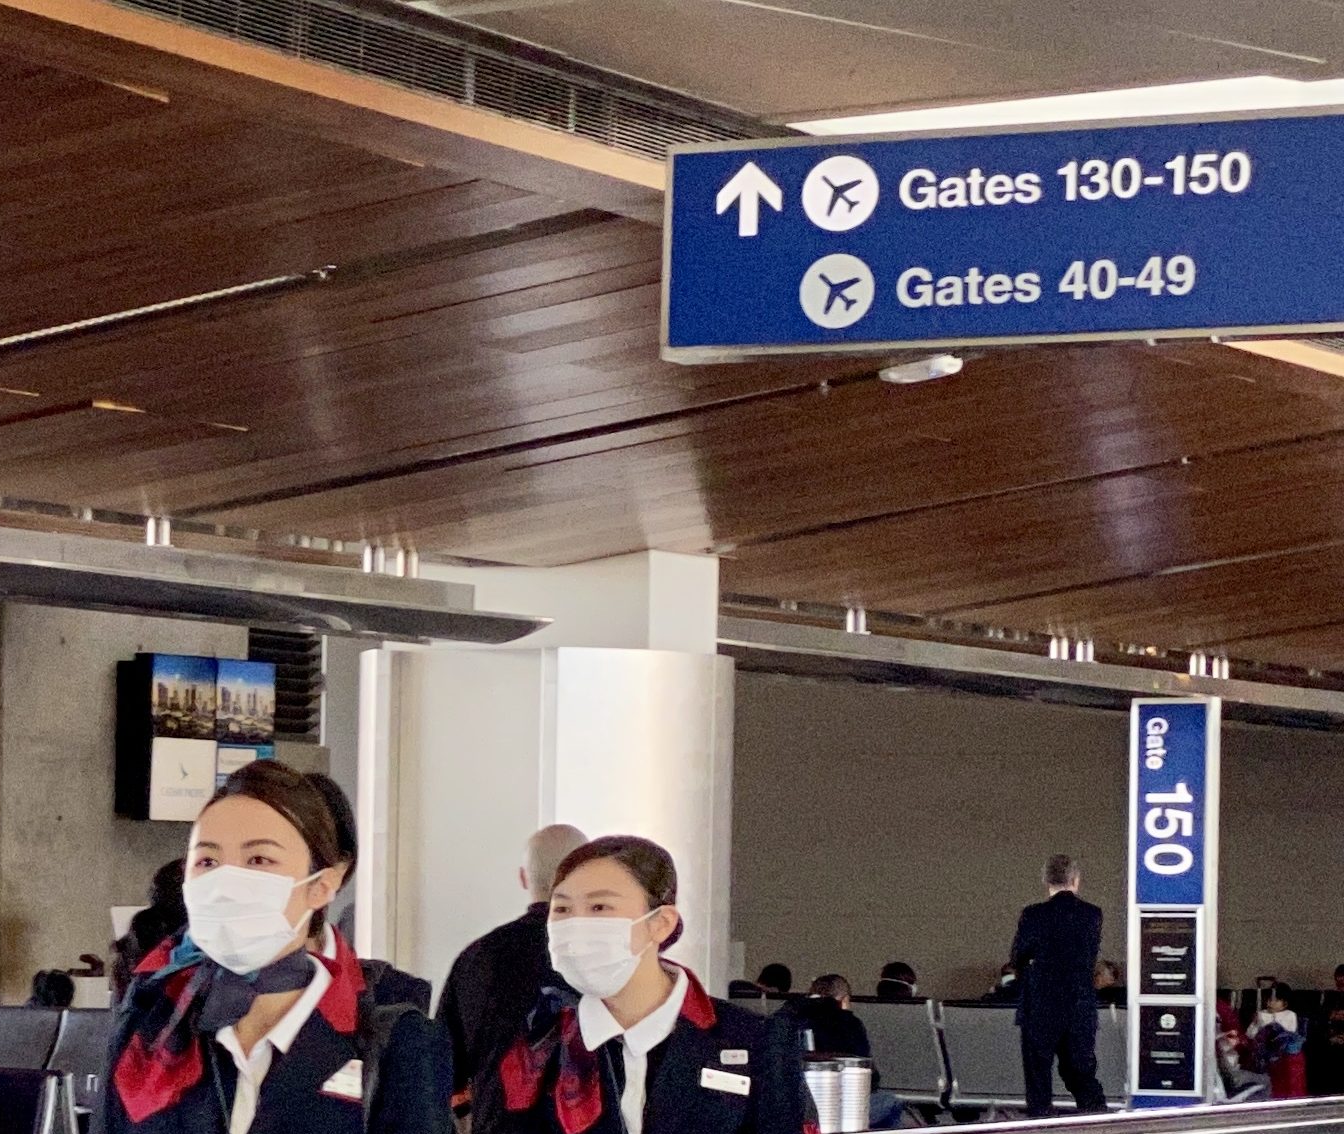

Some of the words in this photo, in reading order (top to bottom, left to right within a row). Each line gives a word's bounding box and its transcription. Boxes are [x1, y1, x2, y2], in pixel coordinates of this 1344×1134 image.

[898, 167, 1043, 210] Gates
[1057, 151, 1252, 201] 130-150
[896, 267, 1042, 308] Gates
[1058, 254, 1196, 300] 40-49
[1144, 717, 1169, 771] Gate
[1143, 782, 1194, 876] 150
